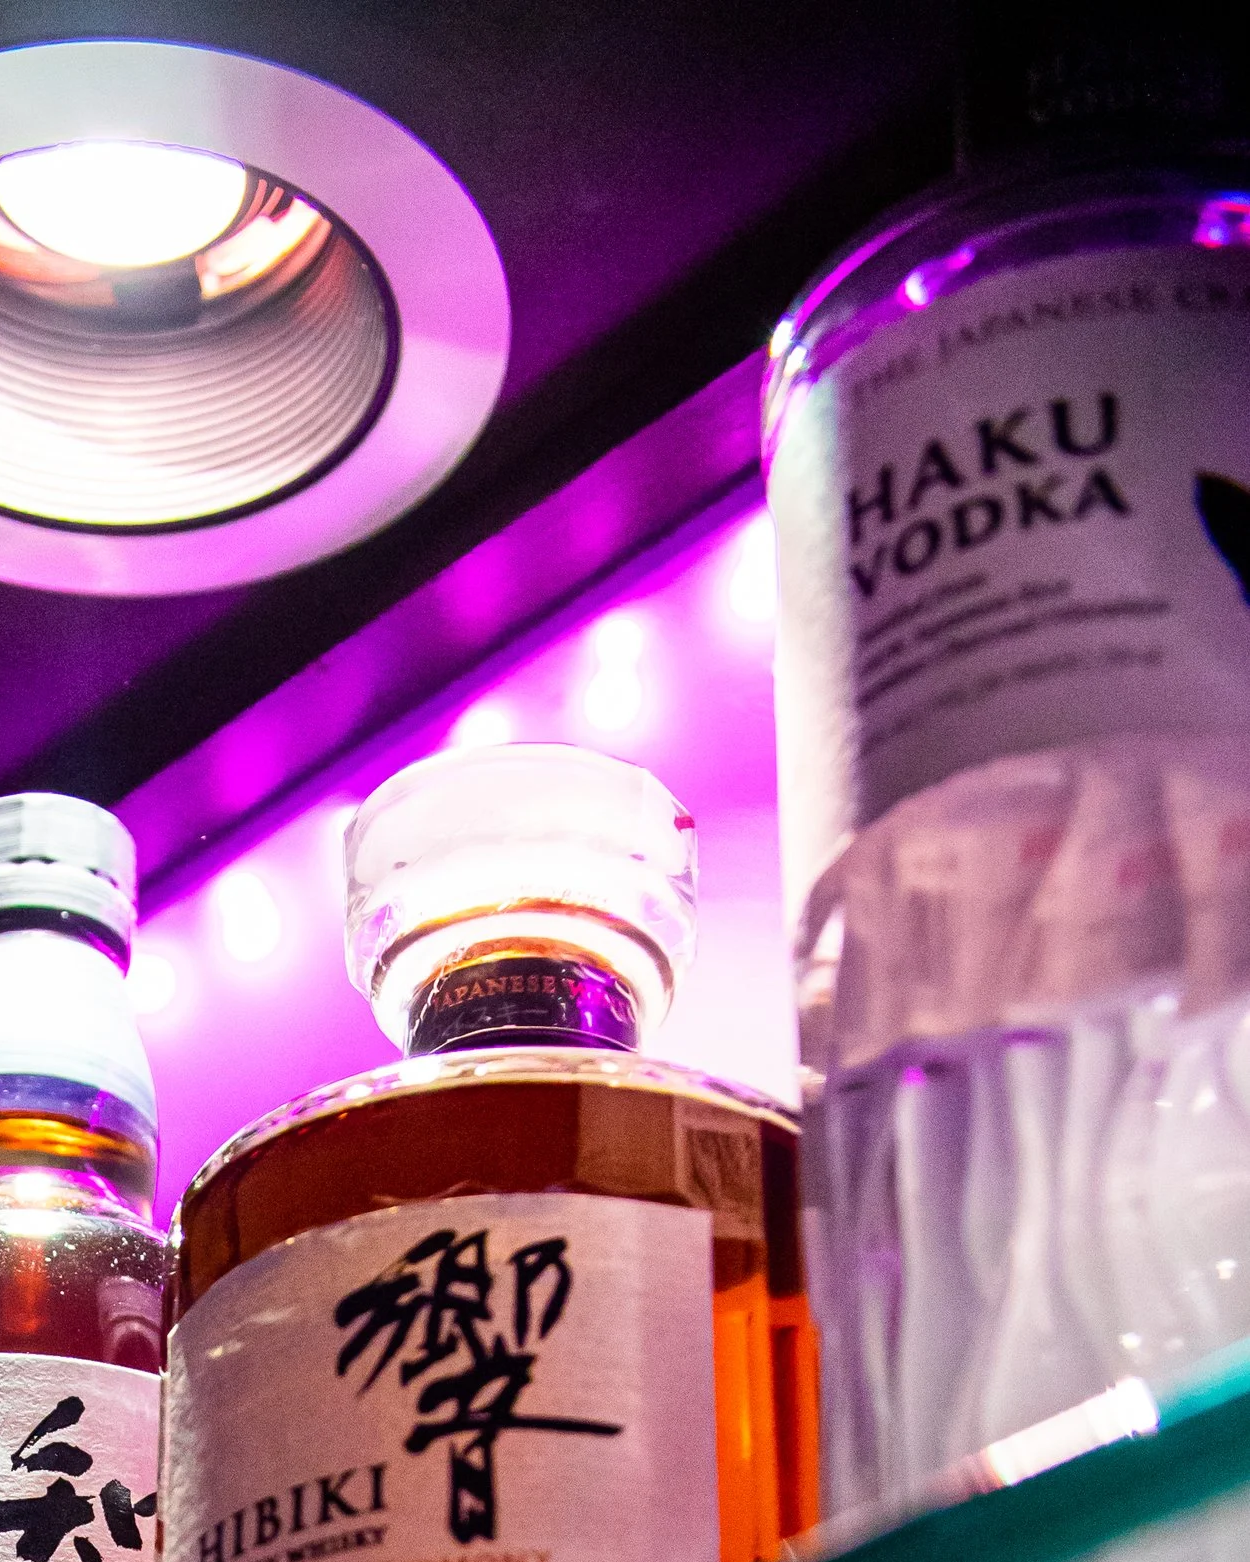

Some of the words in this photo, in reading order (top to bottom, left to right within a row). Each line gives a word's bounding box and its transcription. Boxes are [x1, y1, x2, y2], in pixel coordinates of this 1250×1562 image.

[847, 389, 1119, 545] HAKU
[849, 467, 1131, 597] VODKA
[432, 974, 556, 1012] JAPANESE
